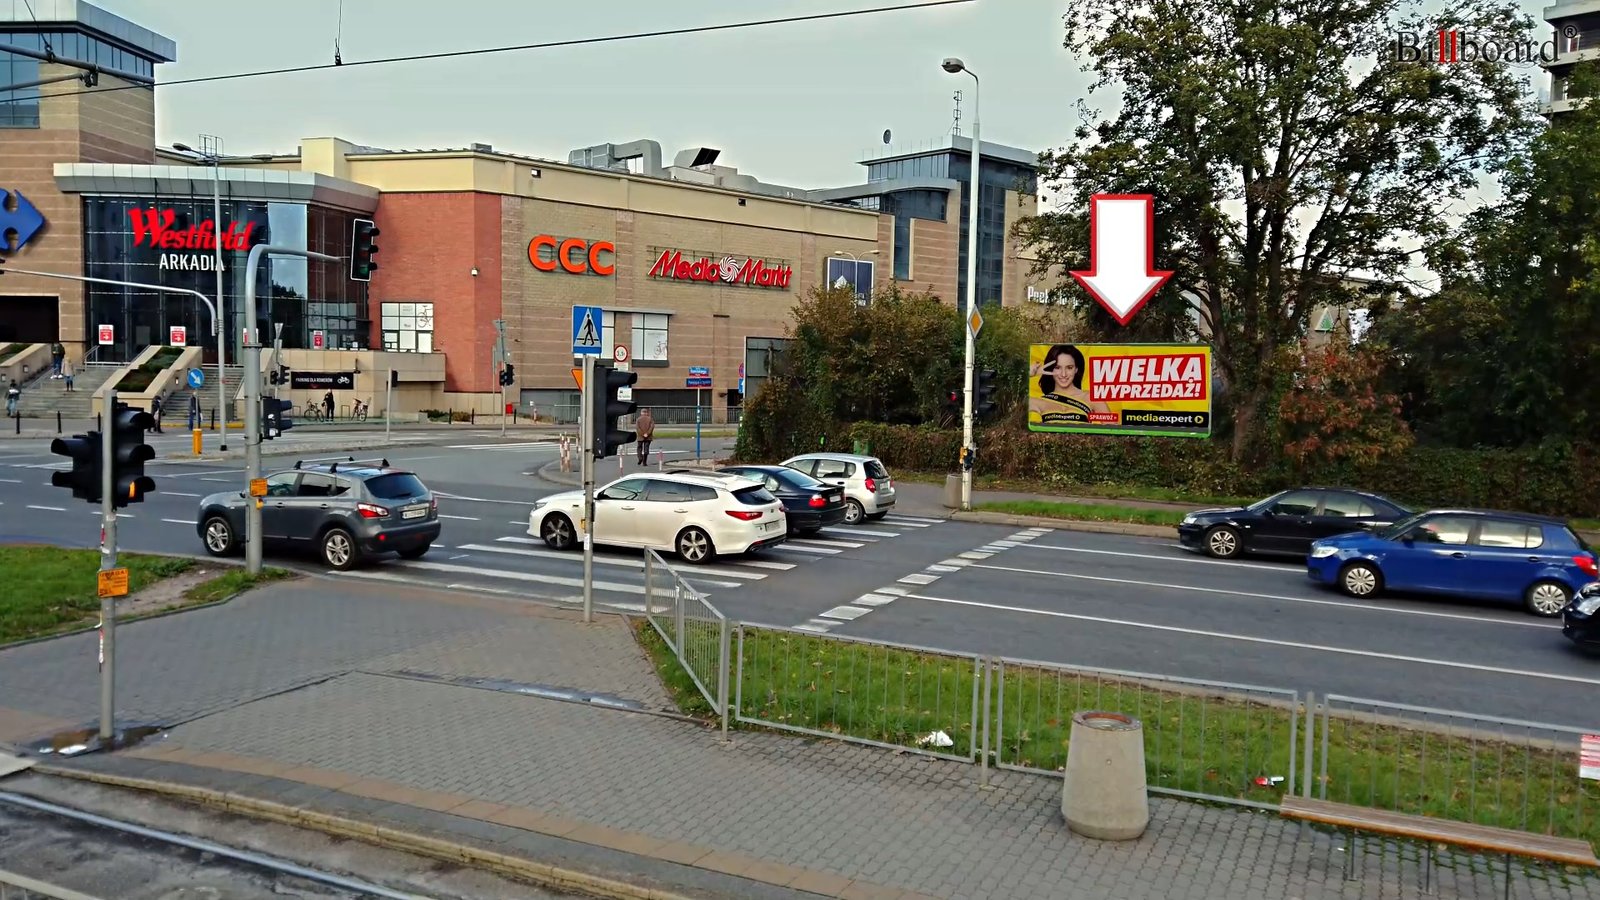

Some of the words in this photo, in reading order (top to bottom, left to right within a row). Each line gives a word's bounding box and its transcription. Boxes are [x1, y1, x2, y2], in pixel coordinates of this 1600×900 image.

[128, 207, 256, 250] Westfield
[159, 253, 225, 271] ARKADIA
[528, 234, 615, 275] CCC
[648, 249, 720, 281] Media
[735, 256, 792, 288] Markt
[1093, 357, 1202, 383] WIELKA
[1093, 378, 1202, 399] WYPRZEDAŻ!
[1126, 413, 1193, 424] mediaexpert
